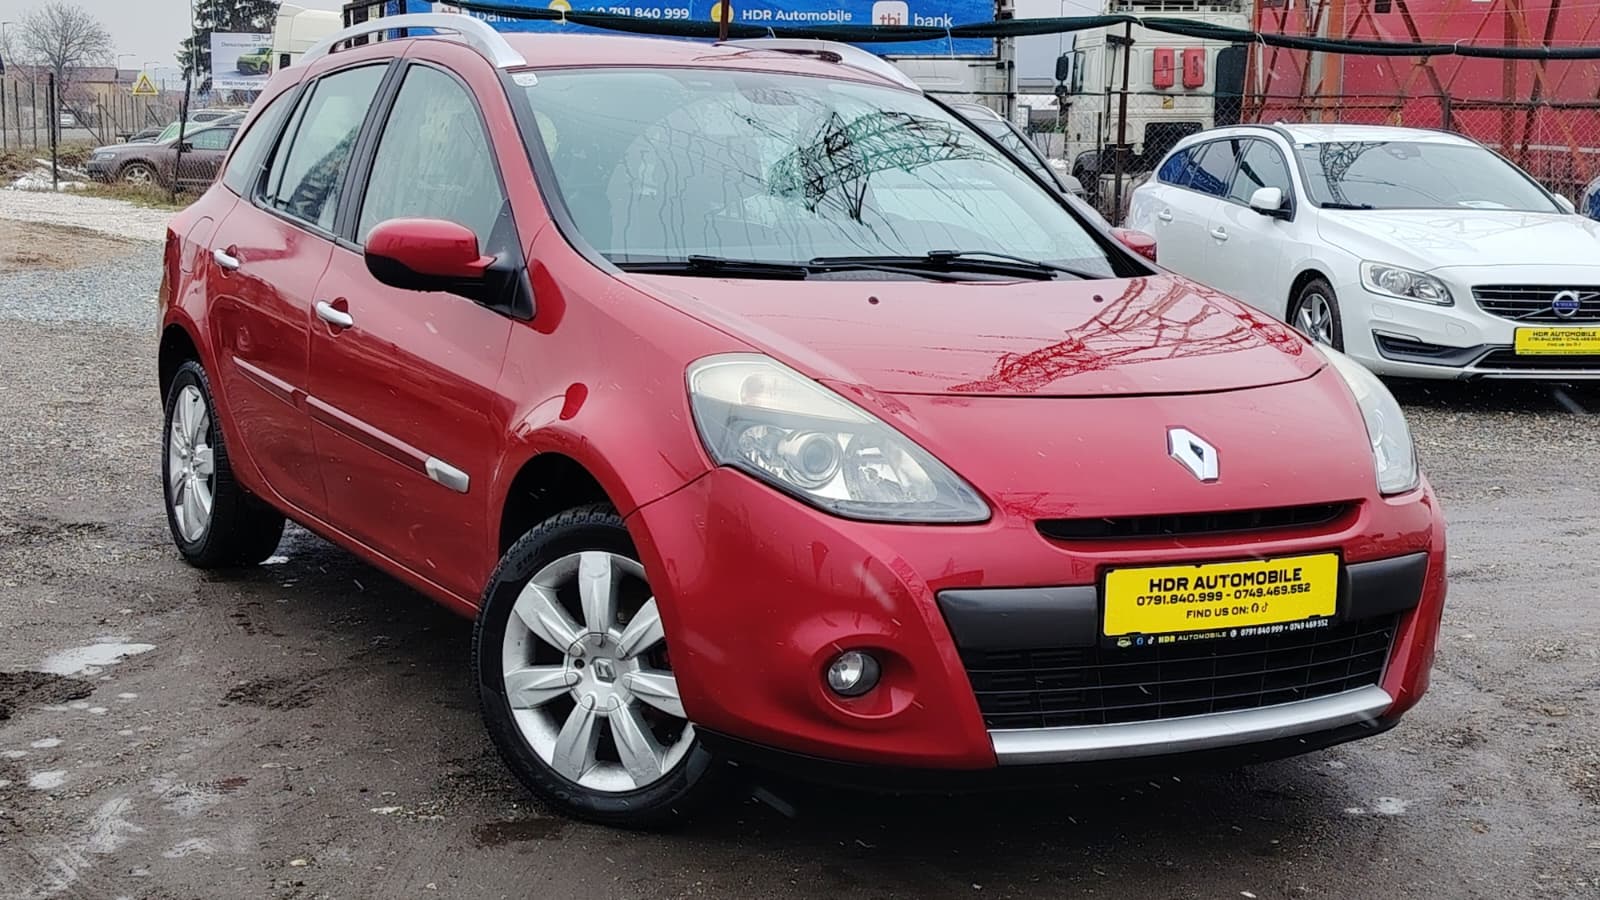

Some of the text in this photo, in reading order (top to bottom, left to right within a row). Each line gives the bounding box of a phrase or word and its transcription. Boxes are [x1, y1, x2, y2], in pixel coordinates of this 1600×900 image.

[634, 7, 661, 18] 840
[664, 8, 689, 19] 999
[742, 9, 852, 22] HDR Automobile
[914, 12, 953, 27] bank
[1149, 568, 1302, 593] HDR AUTOMOBILE
[1137, 591, 1223, 606] 0791.840.999
[1234, 583, 1311, 599] 0749.469.552
[1186, 606, 1249, 619] FIND US ON:
[1158, 635, 1176, 644] HDR
[1177, 631, 1227, 641] AUTOMOBILE
[1240, 628, 1257, 637] 0791
[1271, 624, 1284, 633] 999
